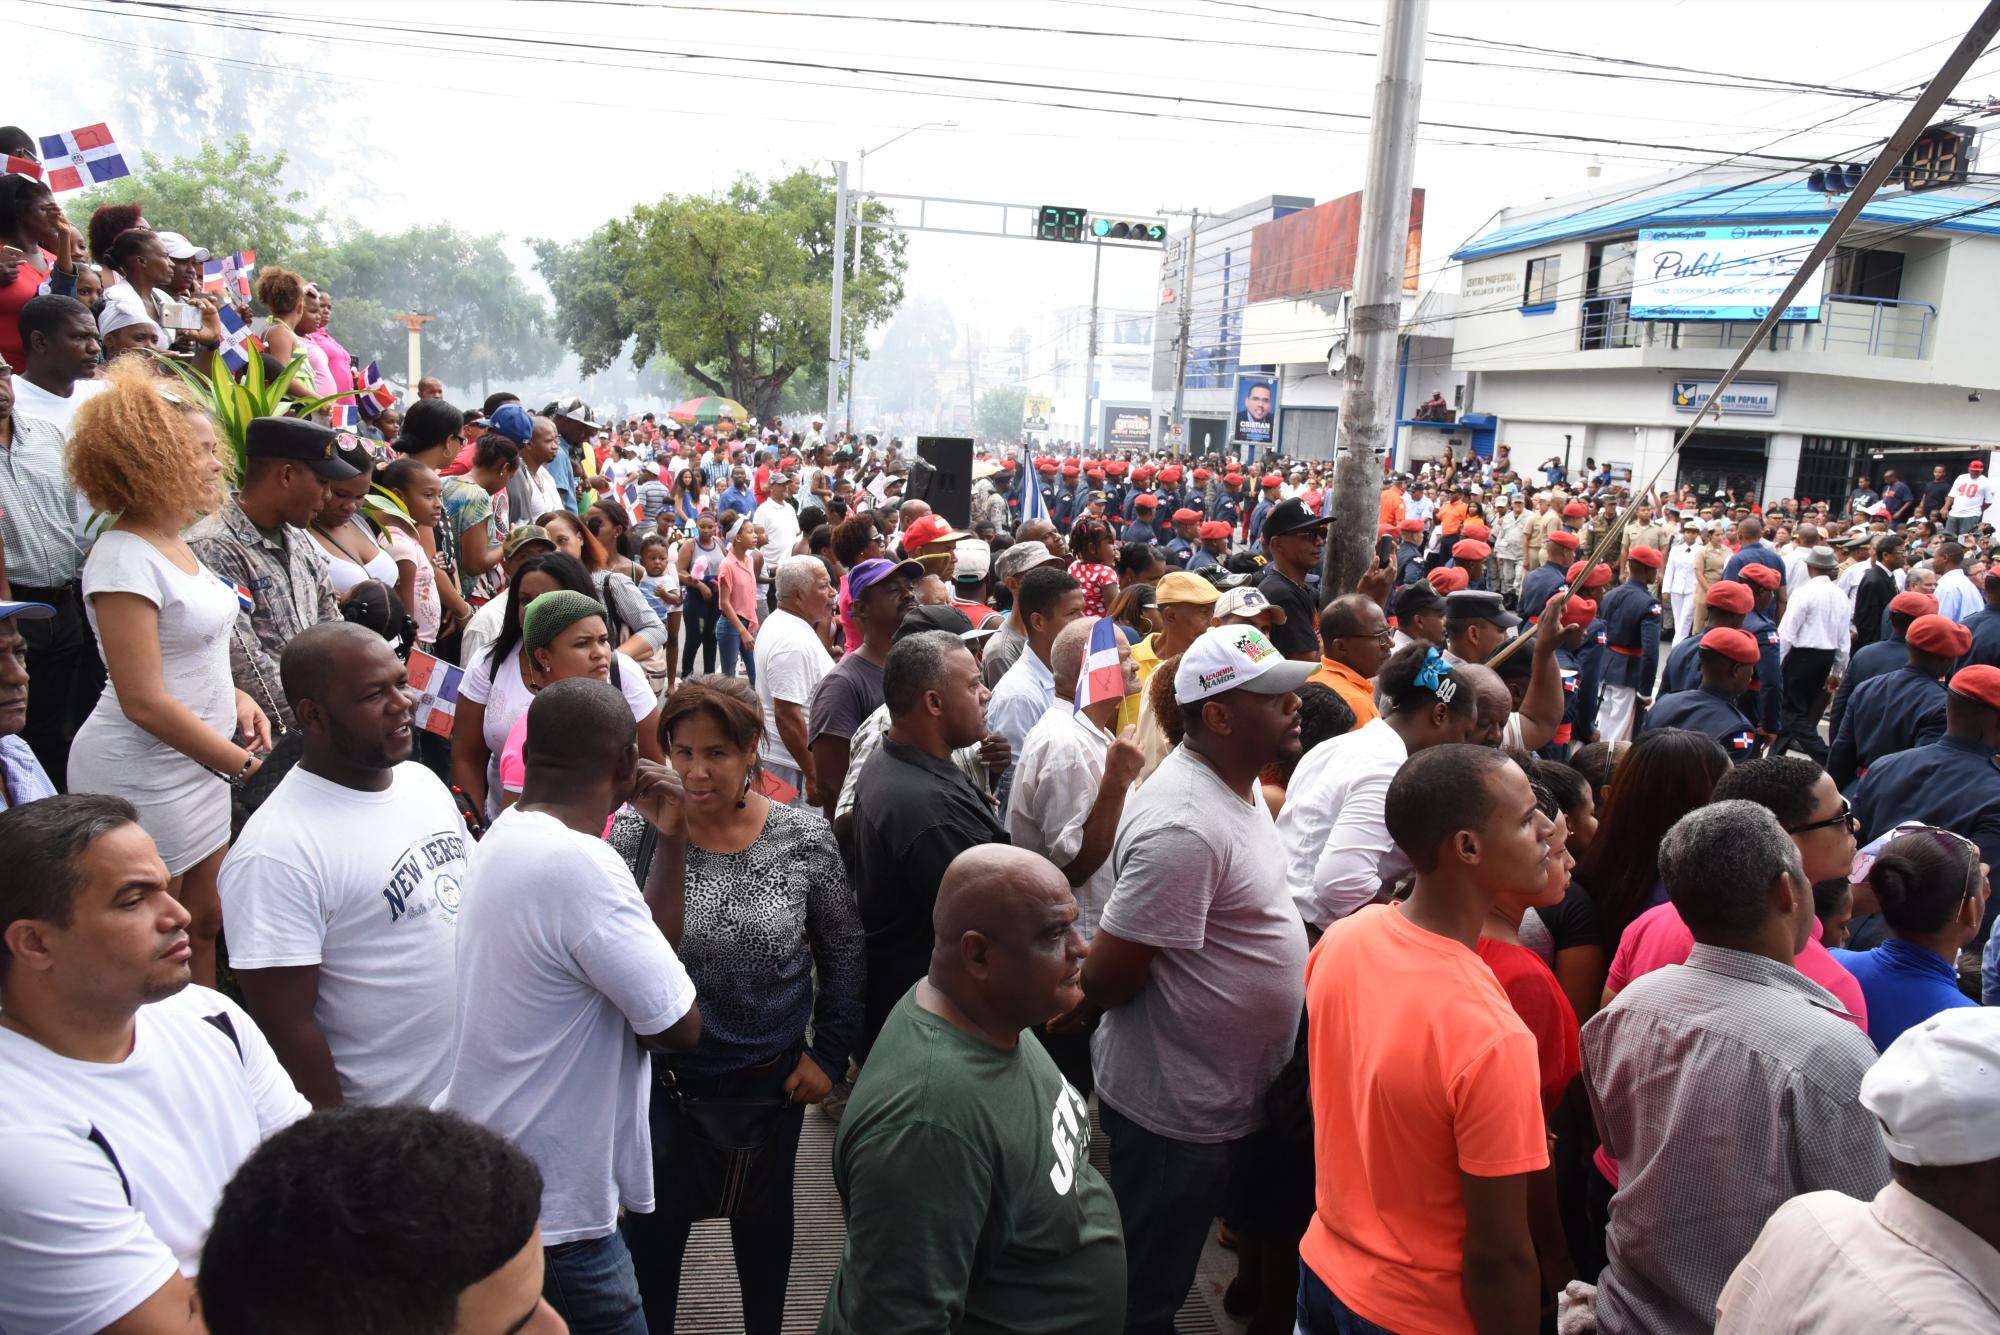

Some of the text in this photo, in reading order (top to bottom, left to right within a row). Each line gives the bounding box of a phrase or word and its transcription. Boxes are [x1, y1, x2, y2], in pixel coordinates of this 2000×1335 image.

[1041, 208, 1080, 241] 22
[1739, 396, 1768, 404] POPULAR
[1240, 421, 1271, 429] CRISTIAN
[1958, 482, 1979, 498] 40
[1205, 666, 1234, 681] ACADEMIA
[1205, 672, 1236, 690] RAMOS
[382, 853, 423, 922] NEW
